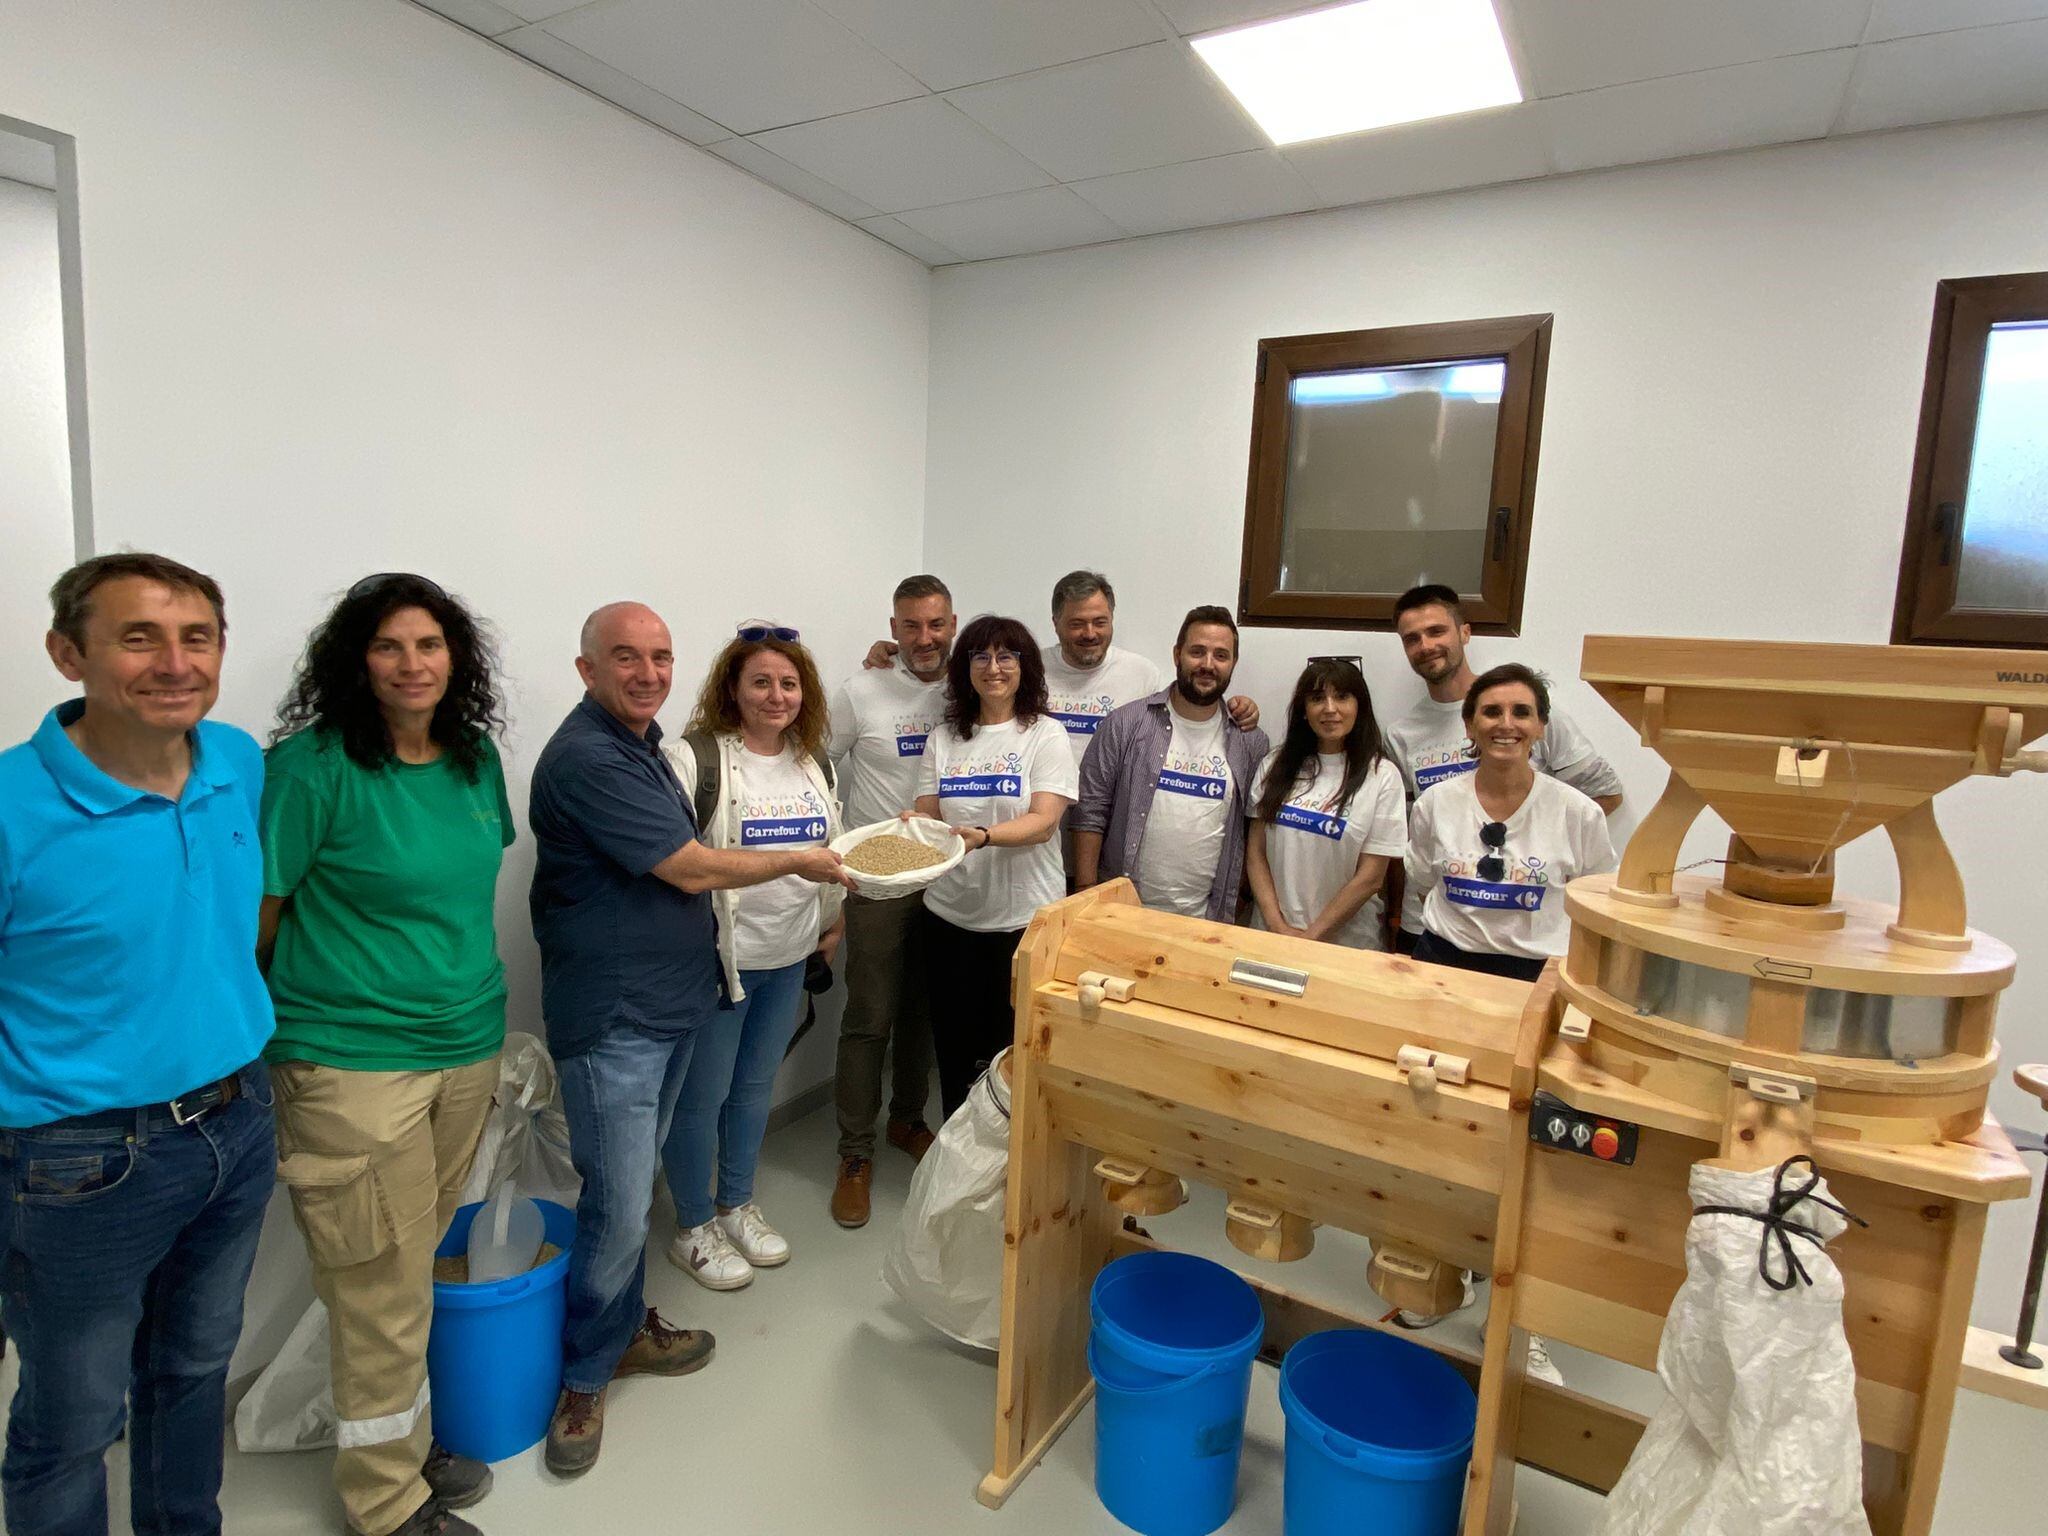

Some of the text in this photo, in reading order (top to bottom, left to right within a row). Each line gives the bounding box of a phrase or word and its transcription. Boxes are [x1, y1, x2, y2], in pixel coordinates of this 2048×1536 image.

[941, 781, 992, 792] Carrefour
[741, 801, 823, 817] SOLIDARIDAD
[1277, 811, 1314, 825] refour
[745, 825, 801, 838] Carrefour
